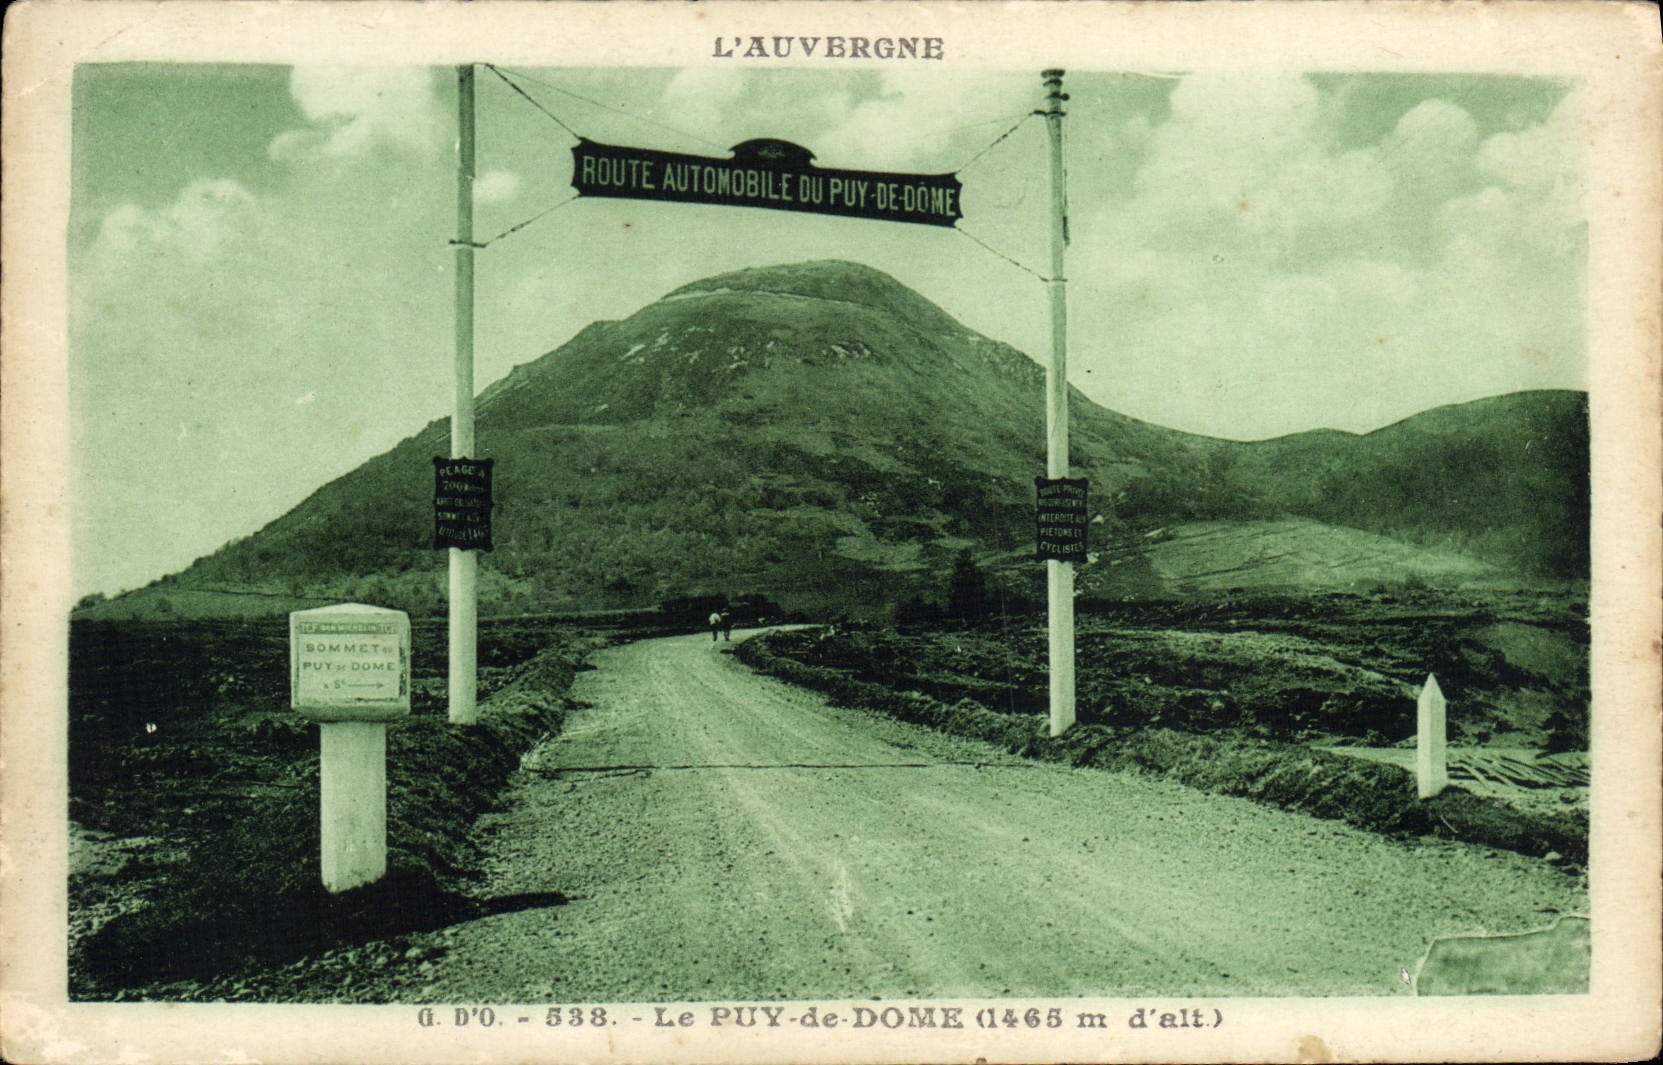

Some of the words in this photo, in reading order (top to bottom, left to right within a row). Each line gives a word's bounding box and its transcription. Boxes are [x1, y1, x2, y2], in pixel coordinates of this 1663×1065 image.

[582, 155, 656, 190] ROUTE
[662, 164, 793, 201] AUTOMOBILE
[799, 176, 823, 204] DU
[439, 465, 476, 478] PEAGE
[1039, 541, 1085, 554] CYCLISTES
[305, 643, 380, 654] SOMMET
[302, 661, 333, 672] PUY
[351, 661, 396, 672] DOME
